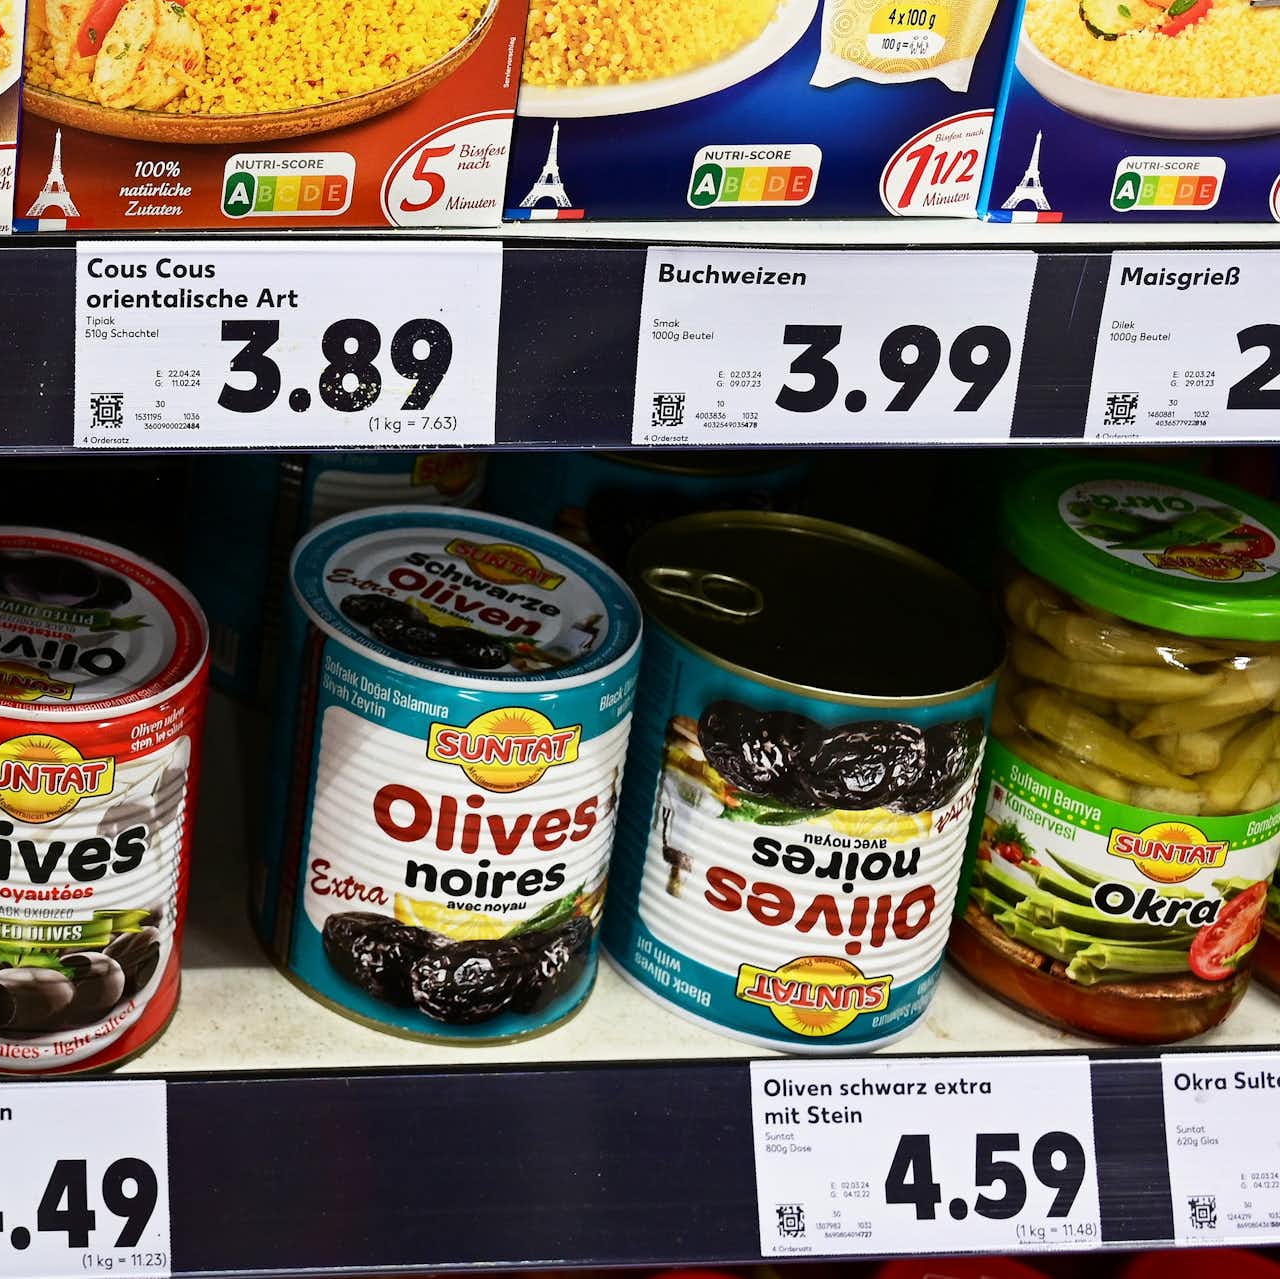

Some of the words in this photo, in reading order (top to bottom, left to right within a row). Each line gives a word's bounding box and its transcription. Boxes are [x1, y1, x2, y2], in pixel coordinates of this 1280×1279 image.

[125, 200, 182, 216] Zutaten
[659, 264, 807, 286] Buchweizen
[1121, 267, 1240, 290] Maisgrieß
[87, 288, 248, 308] orientalische
[256, 288, 298, 308] Art
[653, 319, 679, 328] Smak
[652, 331, 680, 341] 1000g
[683, 331, 714, 340] Beutel
[218, 318, 452, 413] 3.89
[776, 325, 1011, 412] 3.99
[405, 551, 561, 617] Schwarze
[388, 568, 543, 636] Oliven
[1010, 764, 1050, 798] Sultani
[1053, 791, 1103, 822] Bamya
[752, 836, 921, 893] noires
[310, 859, 389, 908] Extra
[447, 900, 480, 912] avec
[483, 901, 526, 913] noyau
[1093, 881, 1220, 928] Okra
[29, 923, 83, 940] OLIVES
[764, 1079, 832, 1096] Oliven
[840, 1079, 927, 1096] schwarz
[935, 1078, 991, 1095] extra
[1174, 1073, 1227, 1091] Okra
[1177, 1137, 1198, 1147] 620g
[1201, 1136, 1219, 1145] Glas
[885, 1131, 1086, 1220] 4.59
